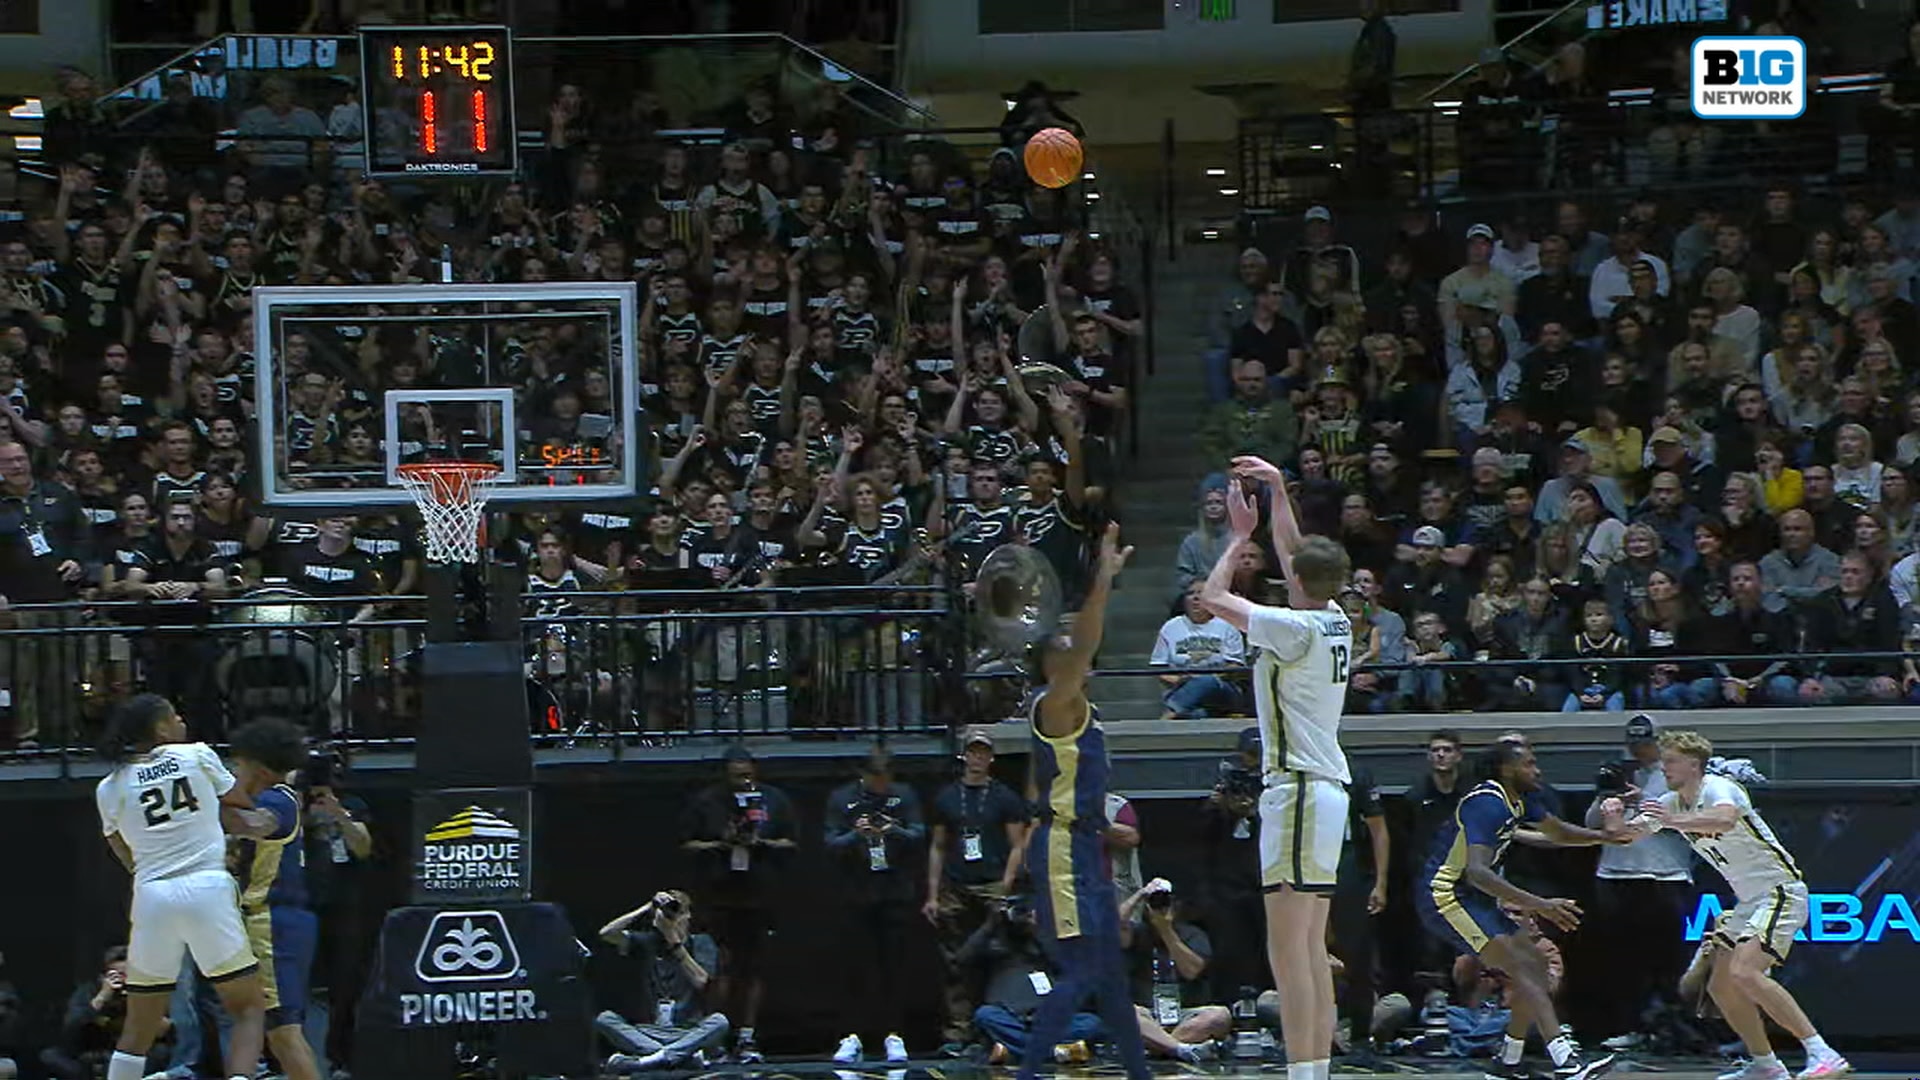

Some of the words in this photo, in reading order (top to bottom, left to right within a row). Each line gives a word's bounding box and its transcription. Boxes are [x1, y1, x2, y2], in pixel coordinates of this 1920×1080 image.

[393, 41, 495, 81] 11:42
[405, 163, 479, 172] DAKTRONICS
[1331, 644, 1348, 683] 12
[137, 758, 180, 784] HARRIS
[139, 776, 200, 827] 24
[424, 843, 520, 862] PURDUE
[424, 862, 519, 879] FEDERAL
[424, 880, 470, 889] CREDIT
[476, 878, 520, 889] UNION
[1685, 893, 1920, 943] ABA
[400, 990, 540, 1024] PIONEER
